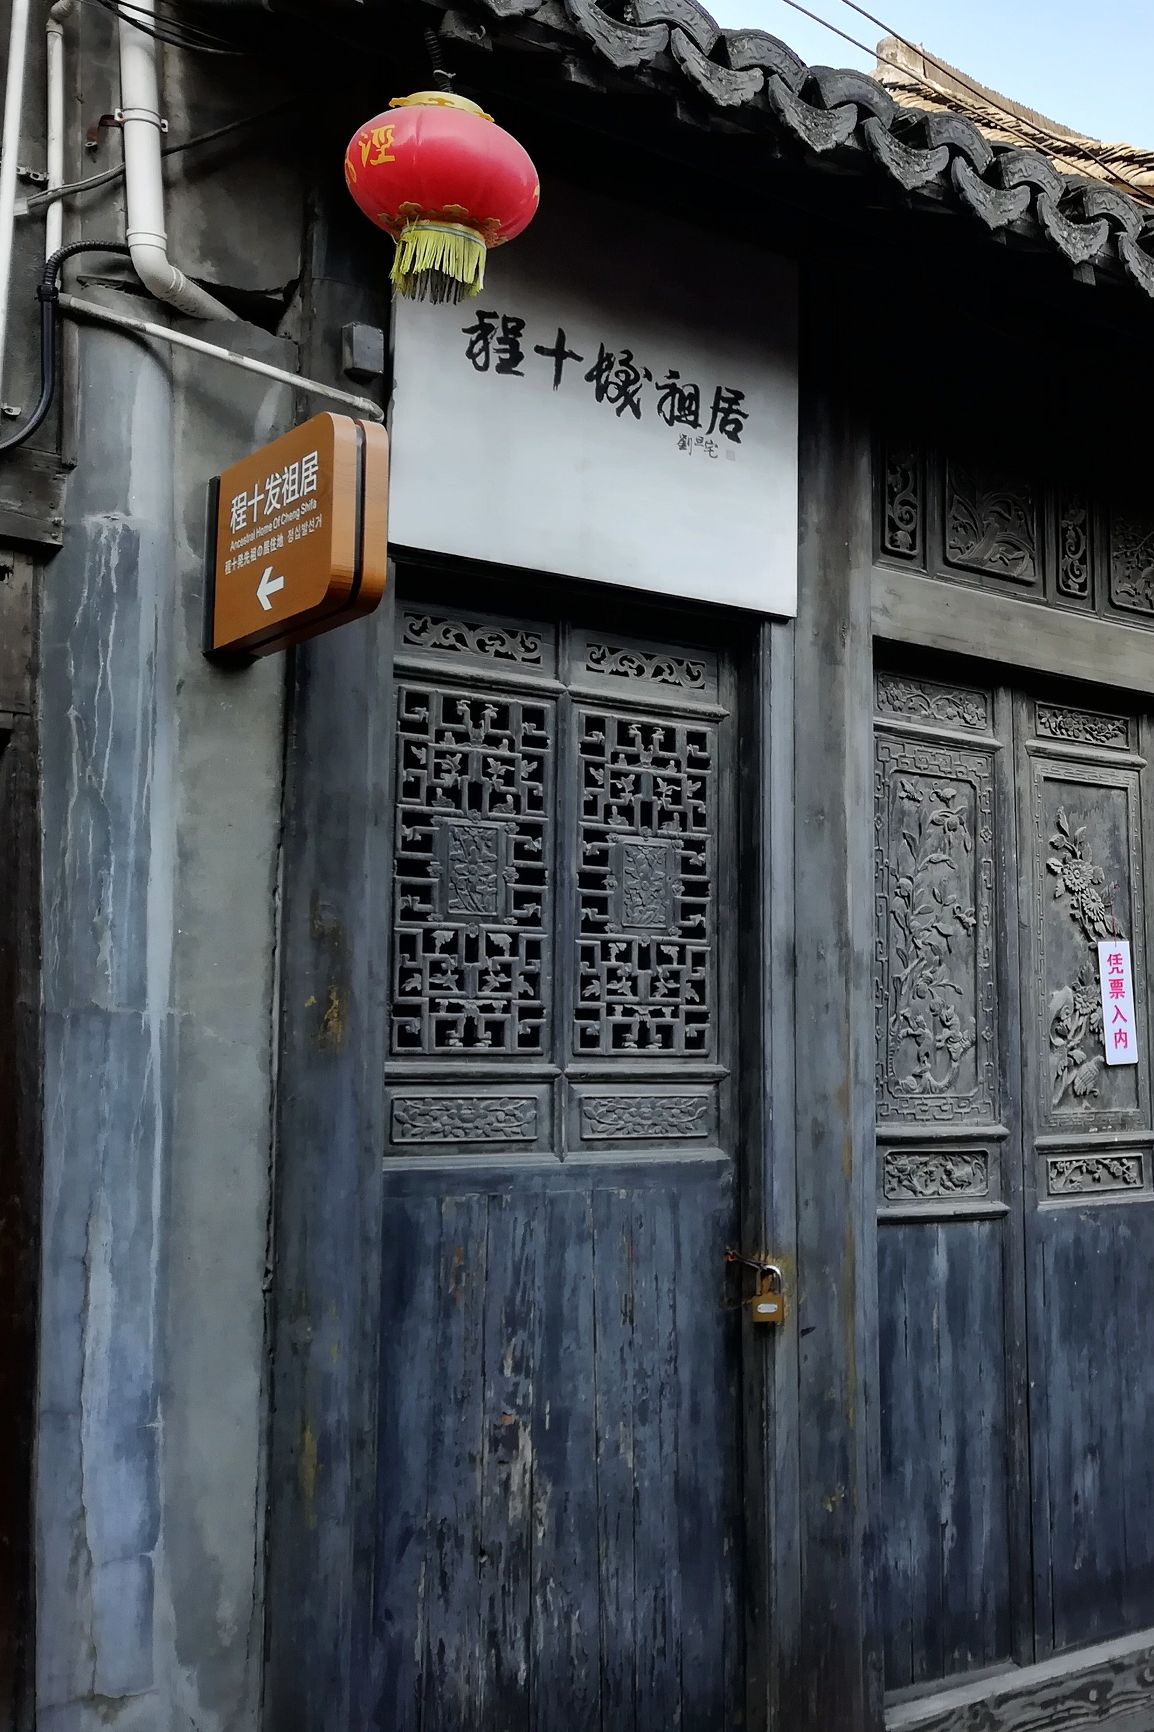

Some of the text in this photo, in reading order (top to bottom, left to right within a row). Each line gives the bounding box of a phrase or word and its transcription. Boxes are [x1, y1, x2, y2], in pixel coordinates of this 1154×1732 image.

[230, 450, 319, 534] 程十发祖居
[230, 498, 317, 552] Ancestral Home Of Cheng Shifa
[1107, 952, 1128, 1050] 凭票入内
